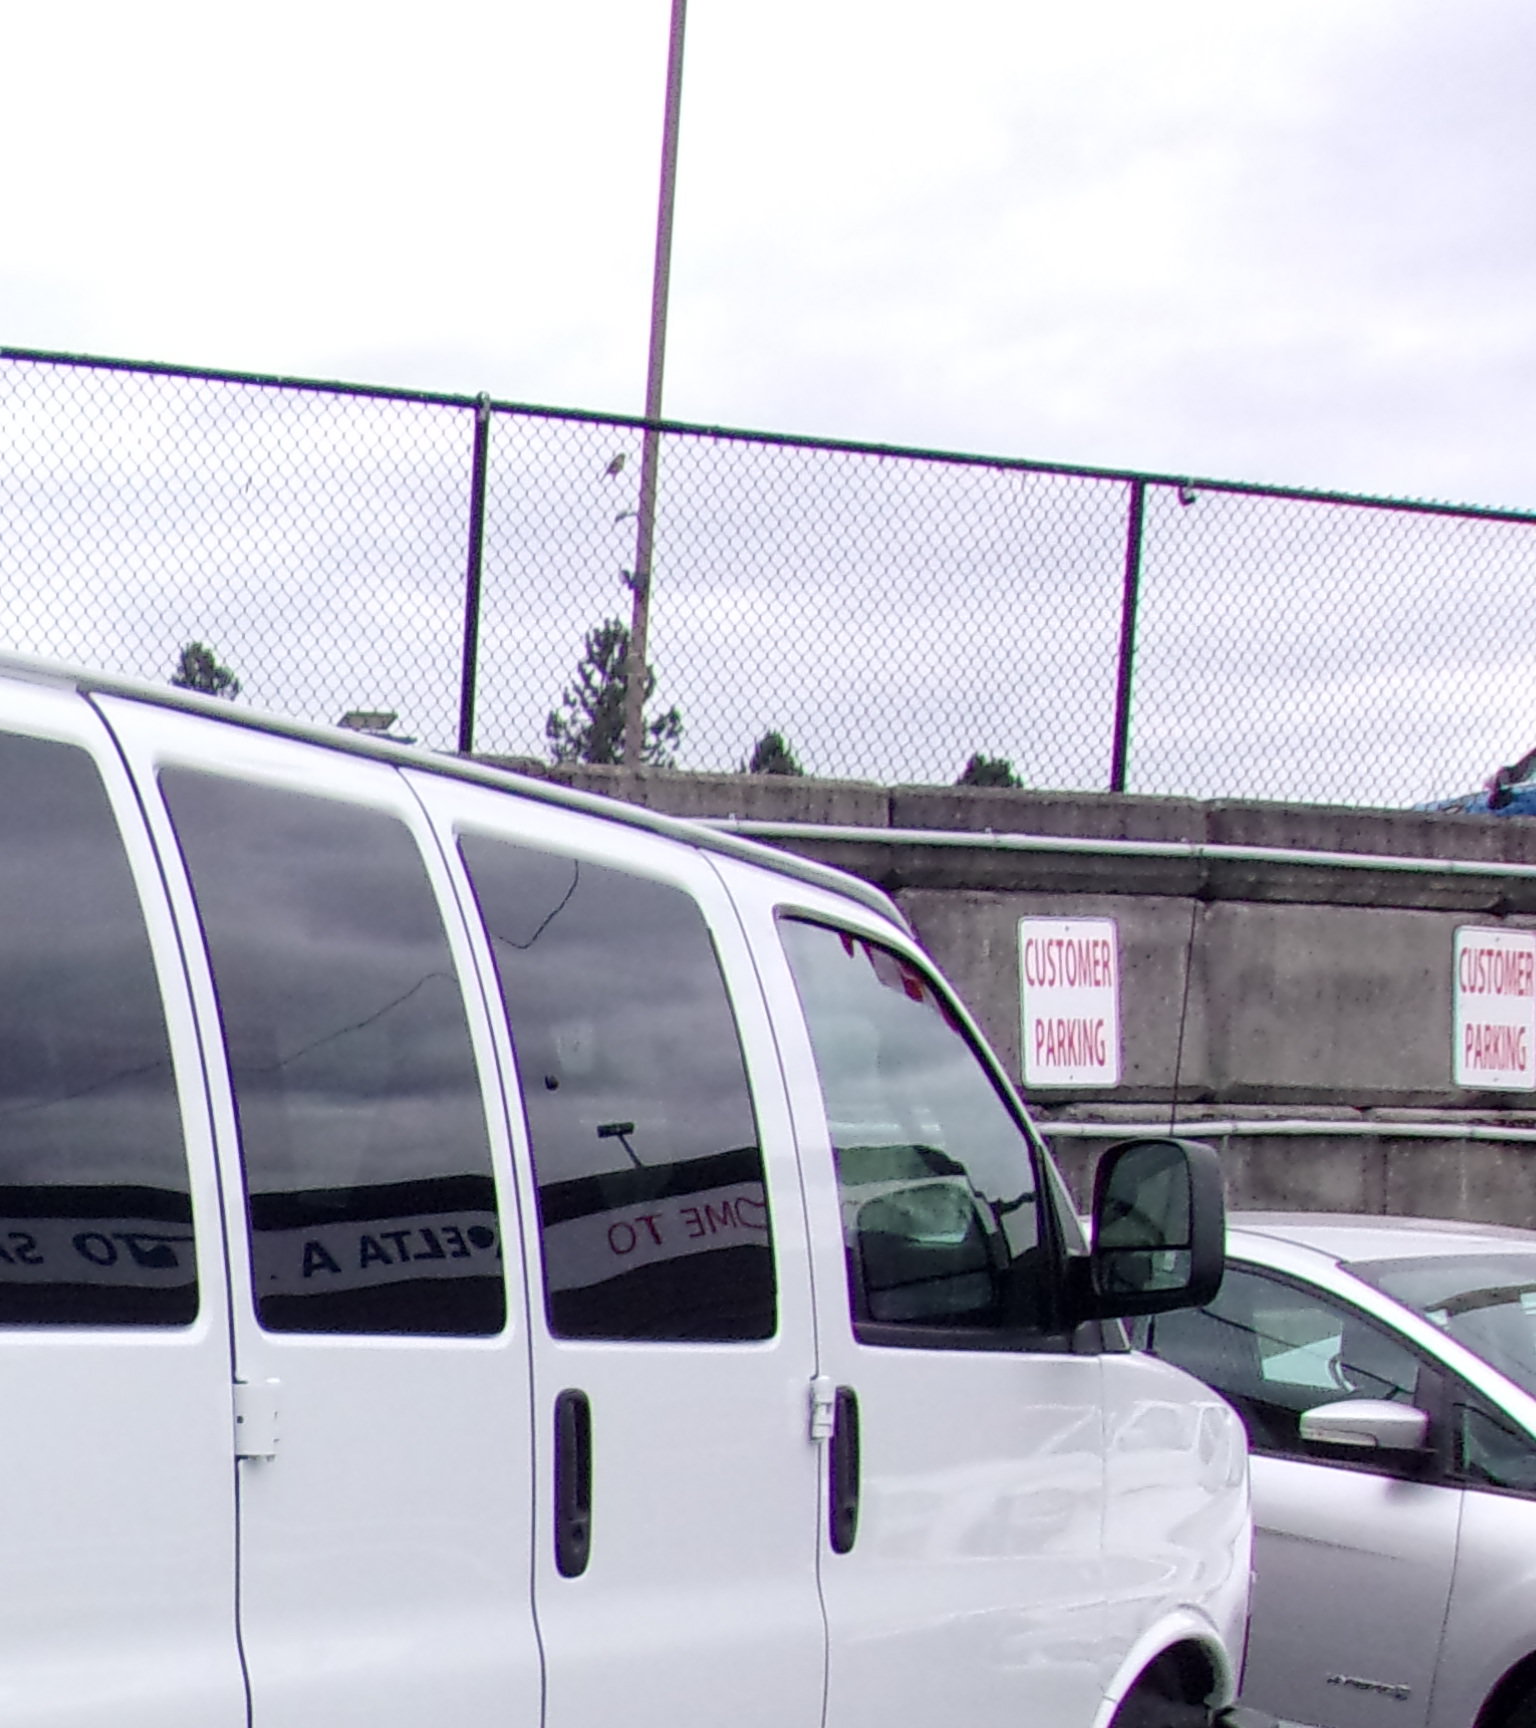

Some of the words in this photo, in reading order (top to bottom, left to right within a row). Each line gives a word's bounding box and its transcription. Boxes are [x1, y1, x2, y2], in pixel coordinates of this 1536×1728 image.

[1024, 938, 1112, 987] CUSTOMER
[1459, 947, 1535, 996] CUSTOMER
[1035, 1019, 1106, 1068] PARKING
[1465, 1023, 1527, 1072] PARKING
